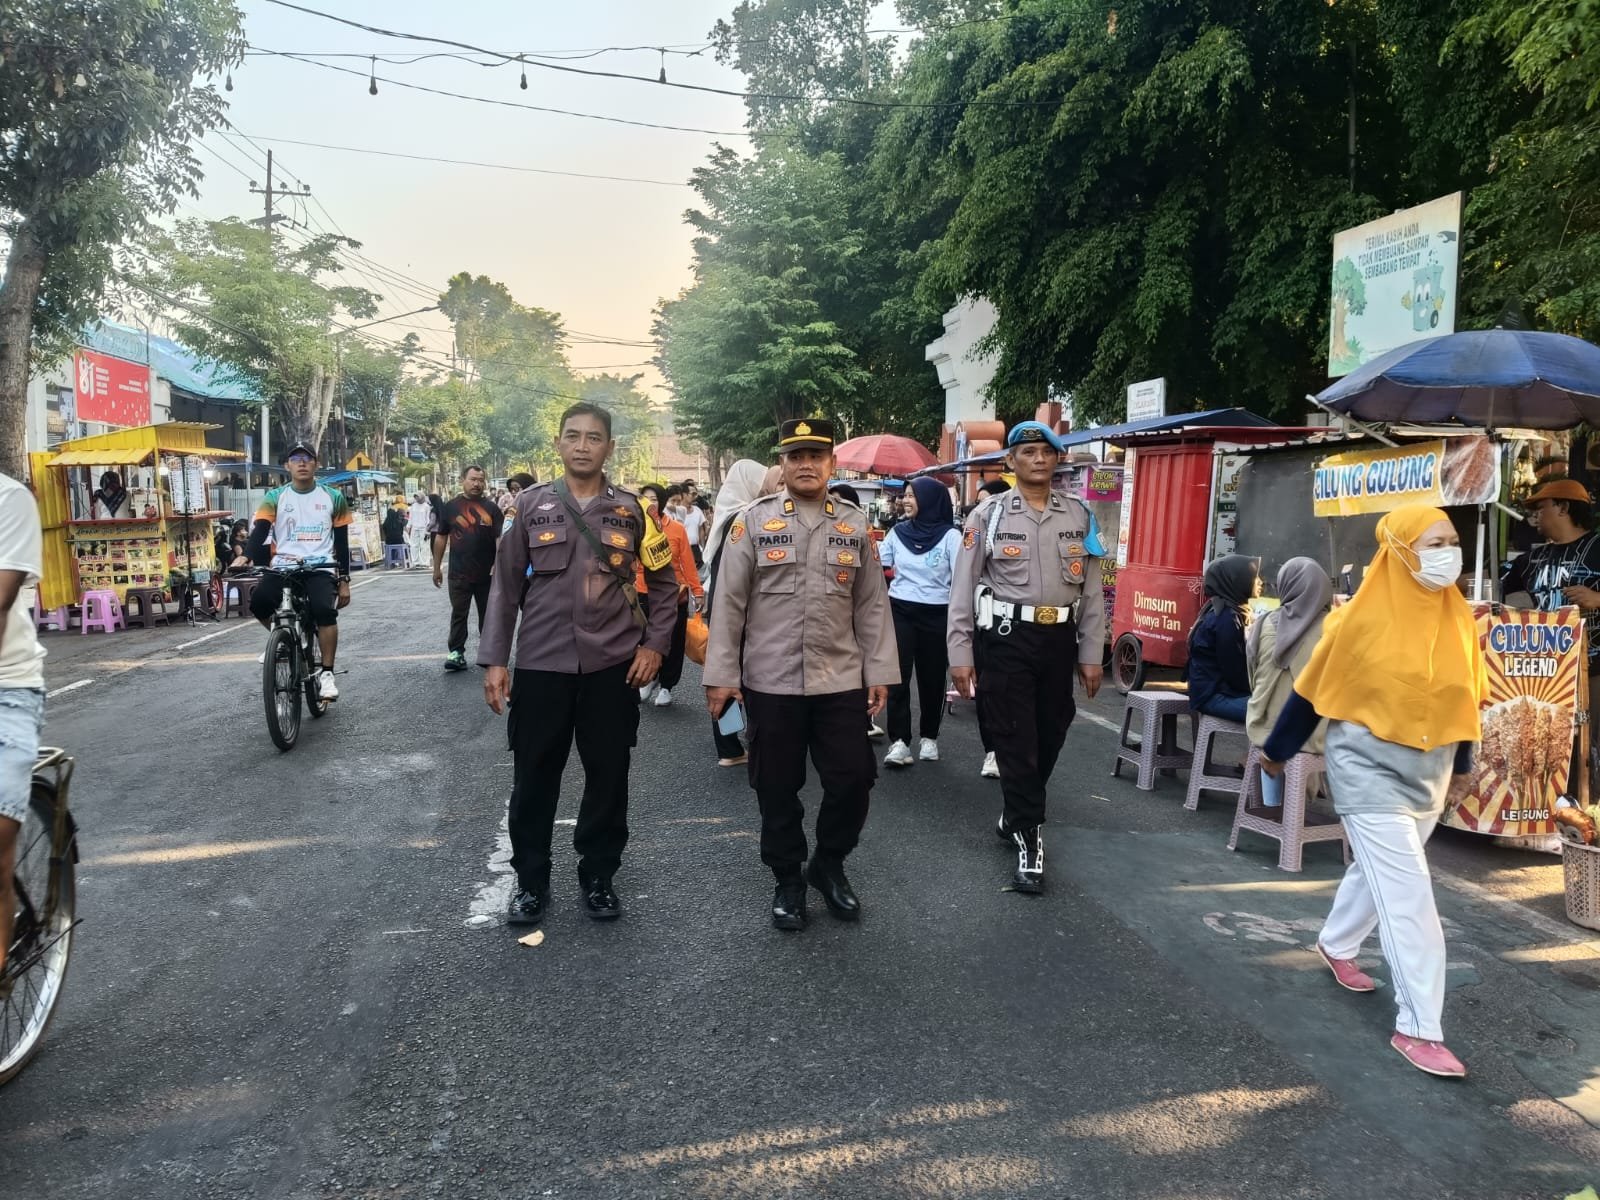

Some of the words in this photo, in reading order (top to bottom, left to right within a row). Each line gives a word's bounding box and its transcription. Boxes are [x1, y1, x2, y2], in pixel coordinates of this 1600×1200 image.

[1365, 233, 1385, 250] TERIMA
[1386, 226, 1403, 244] KASIH
[1404, 222, 1420, 239] ANDA
[1358, 251, 1374, 267] TIDAK
[1374, 240, 1405, 263] MEMBUANG
[1406, 234, 1430, 253] SAMPAH
[1365, 259, 1398, 280] SEMBARANG
[1399, 251, 1420, 271] TEMPAT
[1366, 453, 1437, 496] GULUNG
[602, 516, 635, 531] POLRI
[1058, 530, 1084, 540] POLRI
[758, 534, 793, 546] PARDI
[828, 536, 859, 548] POLRI
[1133, 590, 1177, 615] Dimsum
[1132, 610, 1160, 631] Nyonya
[1161, 615, 1181, 632] Tan
[1489, 623, 1574, 656] CILUNG
[1503, 656, 1558, 677] LEGEND
